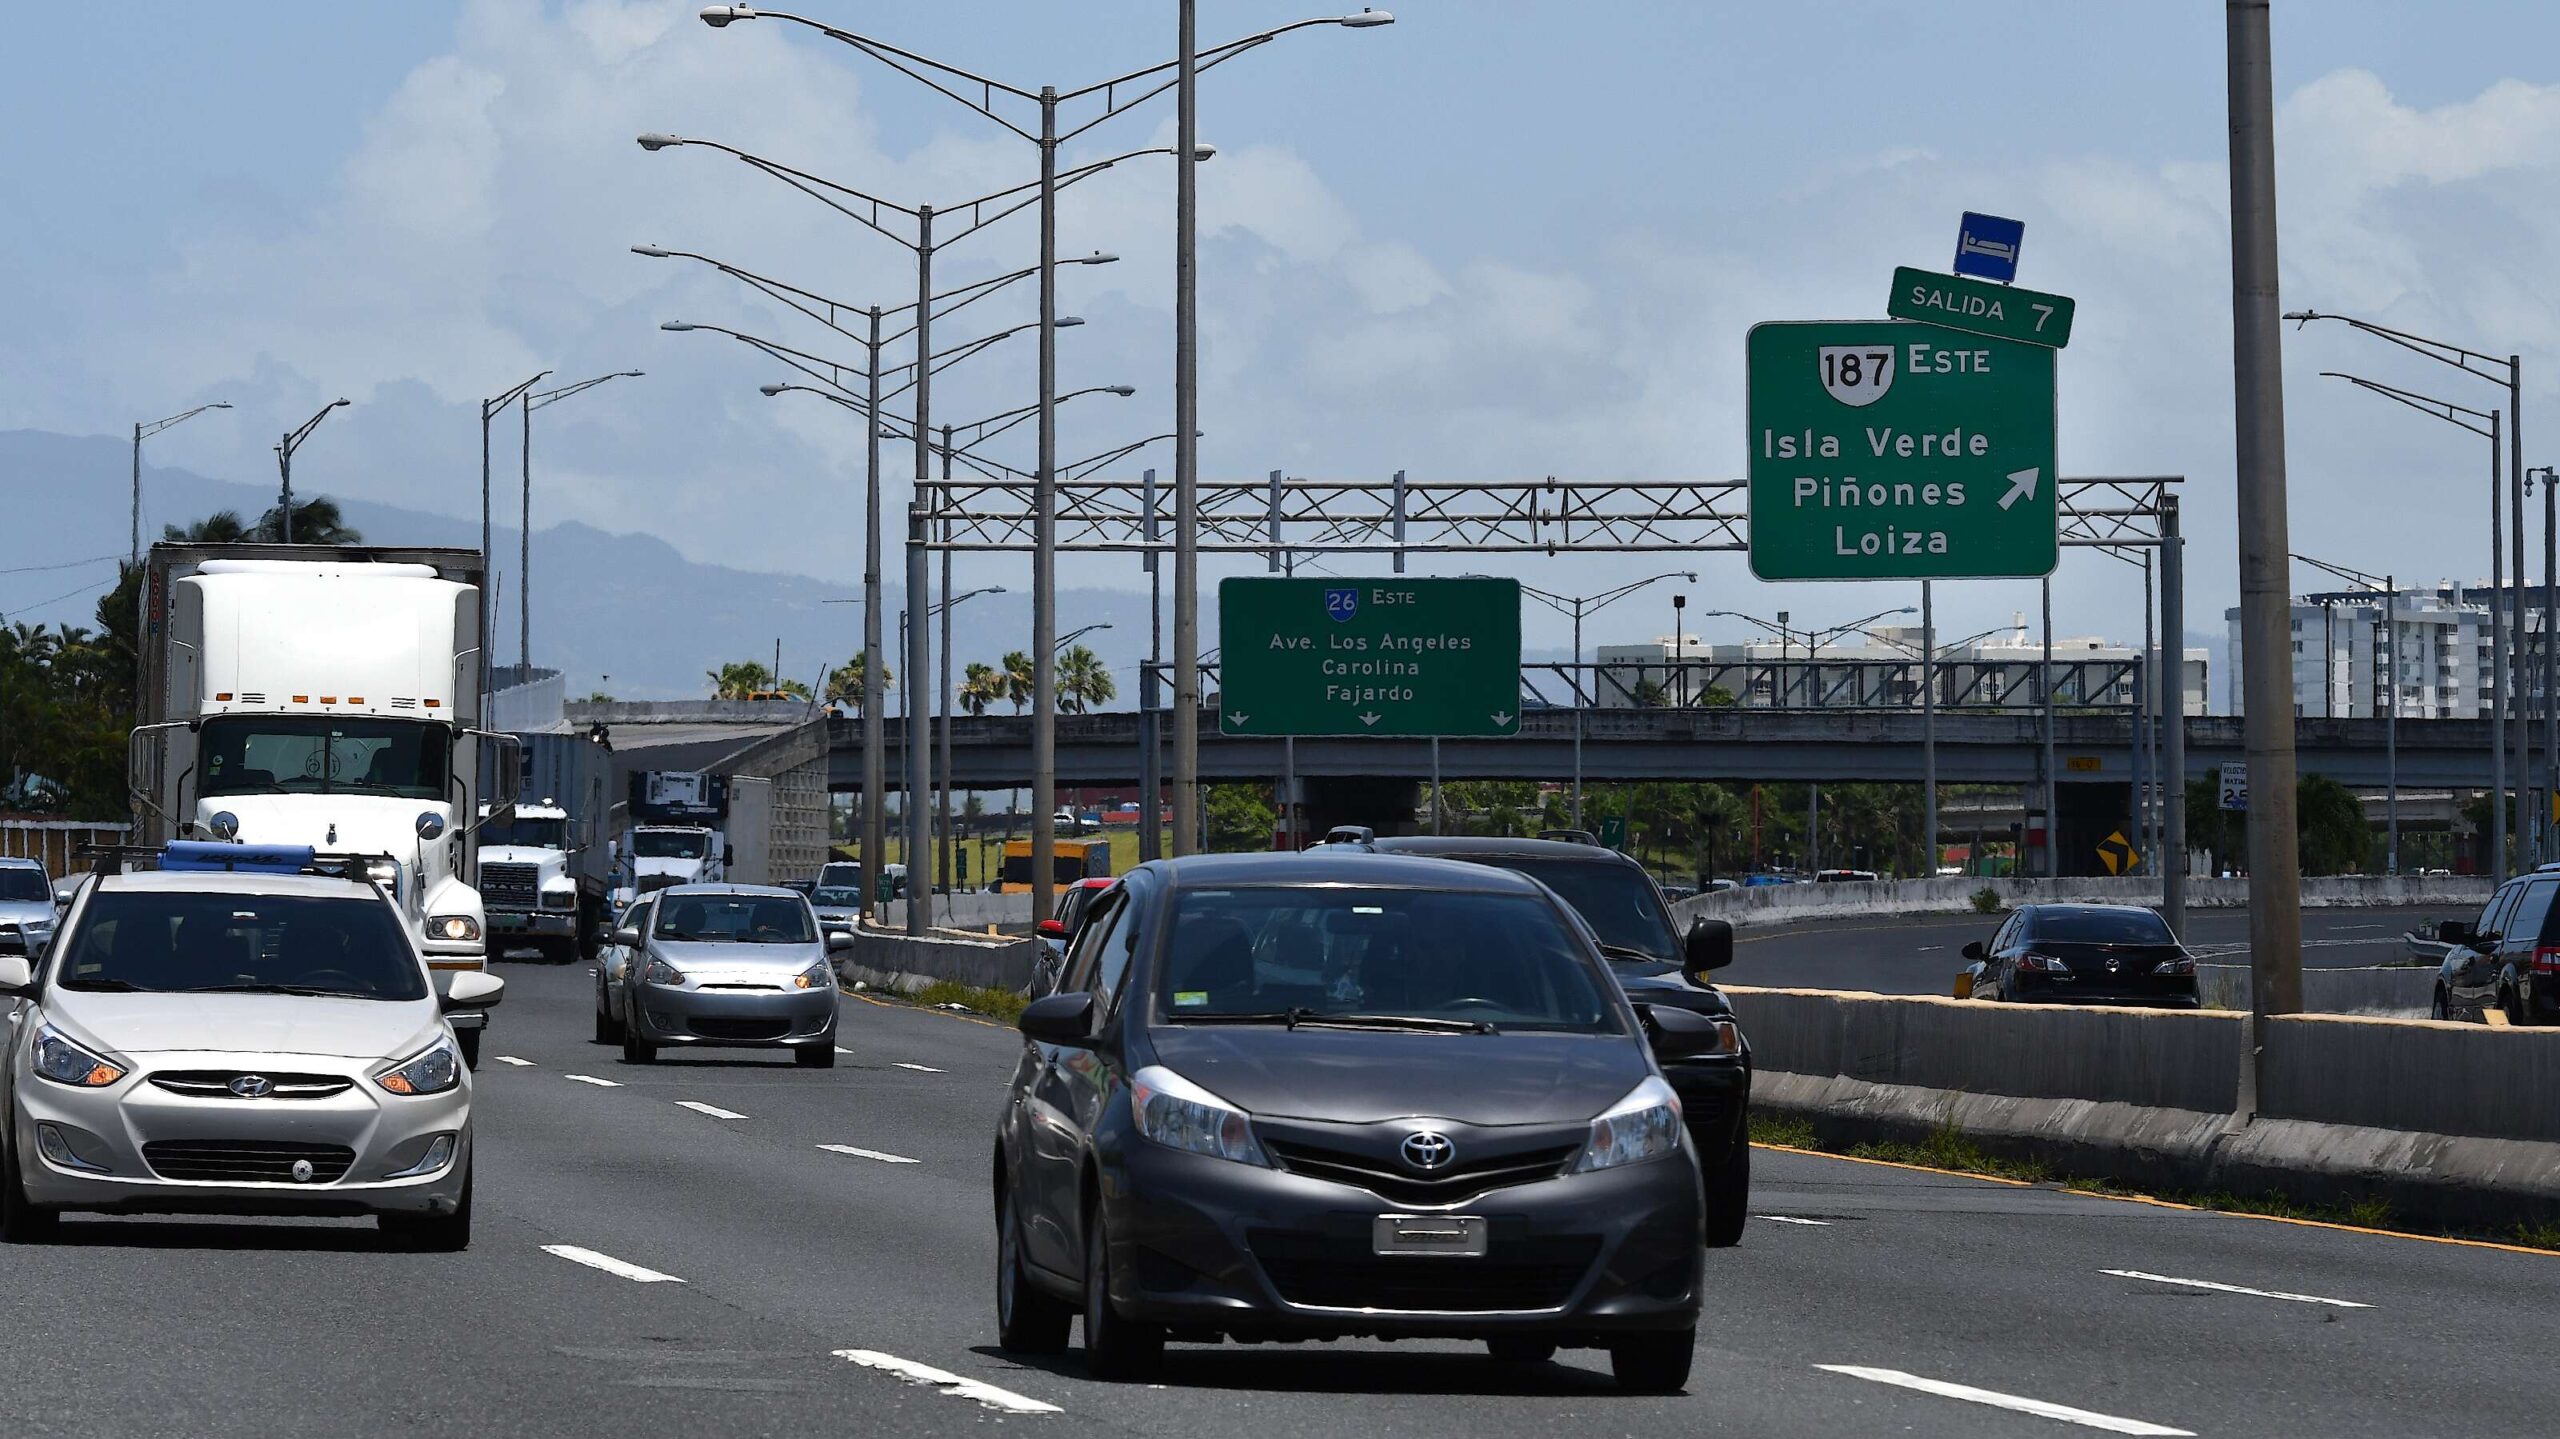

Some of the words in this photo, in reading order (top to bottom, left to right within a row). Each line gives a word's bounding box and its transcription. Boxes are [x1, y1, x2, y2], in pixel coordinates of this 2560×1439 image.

[1911, 286, 2004, 321] SALIDA
[2031, 303, 2054, 332] 7
[1824, 353, 1889, 387] 187
[1908, 343, 1990, 373] ESTE
[1764, 428, 1840, 458] Isla
[1866, 427, 1989, 457] Verde
[1794, 476, 1966, 507] Piñones
[1836, 524, 1948, 555] Loiza
[1328, 593, 1356, 611] 26
[1372, 588, 1416, 604] ESTE
[1269, 633, 1316, 650] Ave.
[1330, 633, 1368, 651] Los
[1379, 632, 1472, 655] Angeles
[1322, 658, 1420, 676] Carolina
[1326, 684, 1414, 706] Fajardo
[1609, 820, 1620, 834] 7
[483, 883, 533, 891] MACK
